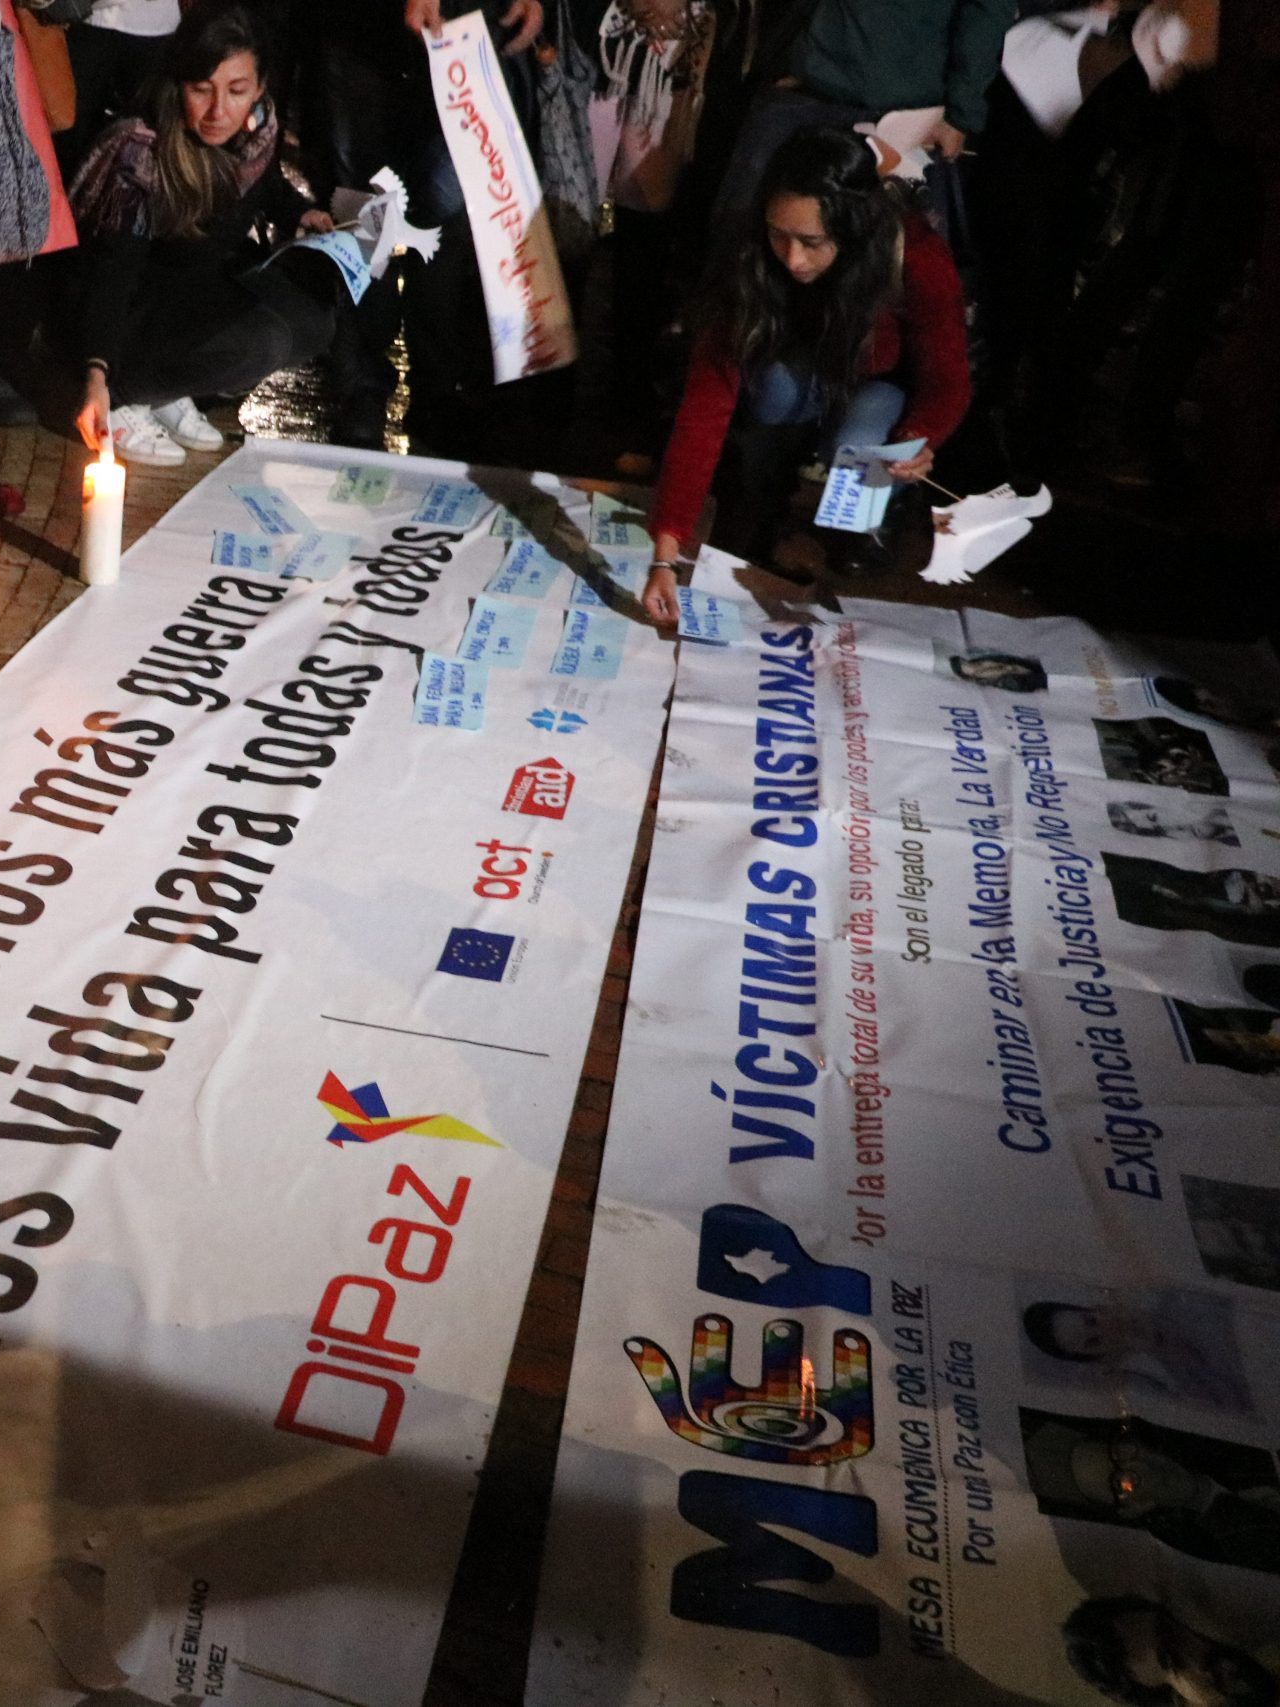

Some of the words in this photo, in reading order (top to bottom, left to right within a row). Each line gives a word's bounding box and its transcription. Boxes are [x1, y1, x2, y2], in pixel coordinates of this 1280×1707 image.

[324, 526, 464, 616] todos
[319, 620, 425, 656] y
[205, 656, 383, 789] todas
[751, 625, 820, 848] CRISTIANAS
[11, 712, 175, 834] más
[526, 765, 568, 809] aid
[842, 763, 868, 787] los
[957, 781, 995, 808] La
[1036, 815, 1075, 845] No
[125, 804, 299, 963] para
[472, 839, 532, 900] act
[896, 839, 933, 902] legado
[850, 882, 872, 902] su
[896, 905, 927, 922] el
[844, 908, 880, 955] vida,
[901, 927, 931, 964] Son
[971, 936, 1016, 967] la
[851, 961, 875, 982] su
[986, 968, 1022, 1008] en
[711, 861, 818, 1164] VÍCTIMAS
[845, 987, 876, 1013] de
[1065, 981, 1117, 1018] de
[846, 1014, 878, 1065] total
[987, 1009, 1051, 1155] Caminar
[850, 1070, 891, 1165] entrega
[1076, 1028, 1163, 1201] Exigencia
[847, 1173, 885, 1198] la
[894, 1326, 925, 1355] LA
[897, 1364, 928, 1410] POR
[937, 1340, 973, 1391] Ética
[958, 1390, 982, 1432] con
[953, 1433, 982, 1475] Paz
[895, 1416, 940, 1562] ECUMÉNICA
[962, 1525, 996, 1565] Por
[907, 1576, 945, 1660] MESA
